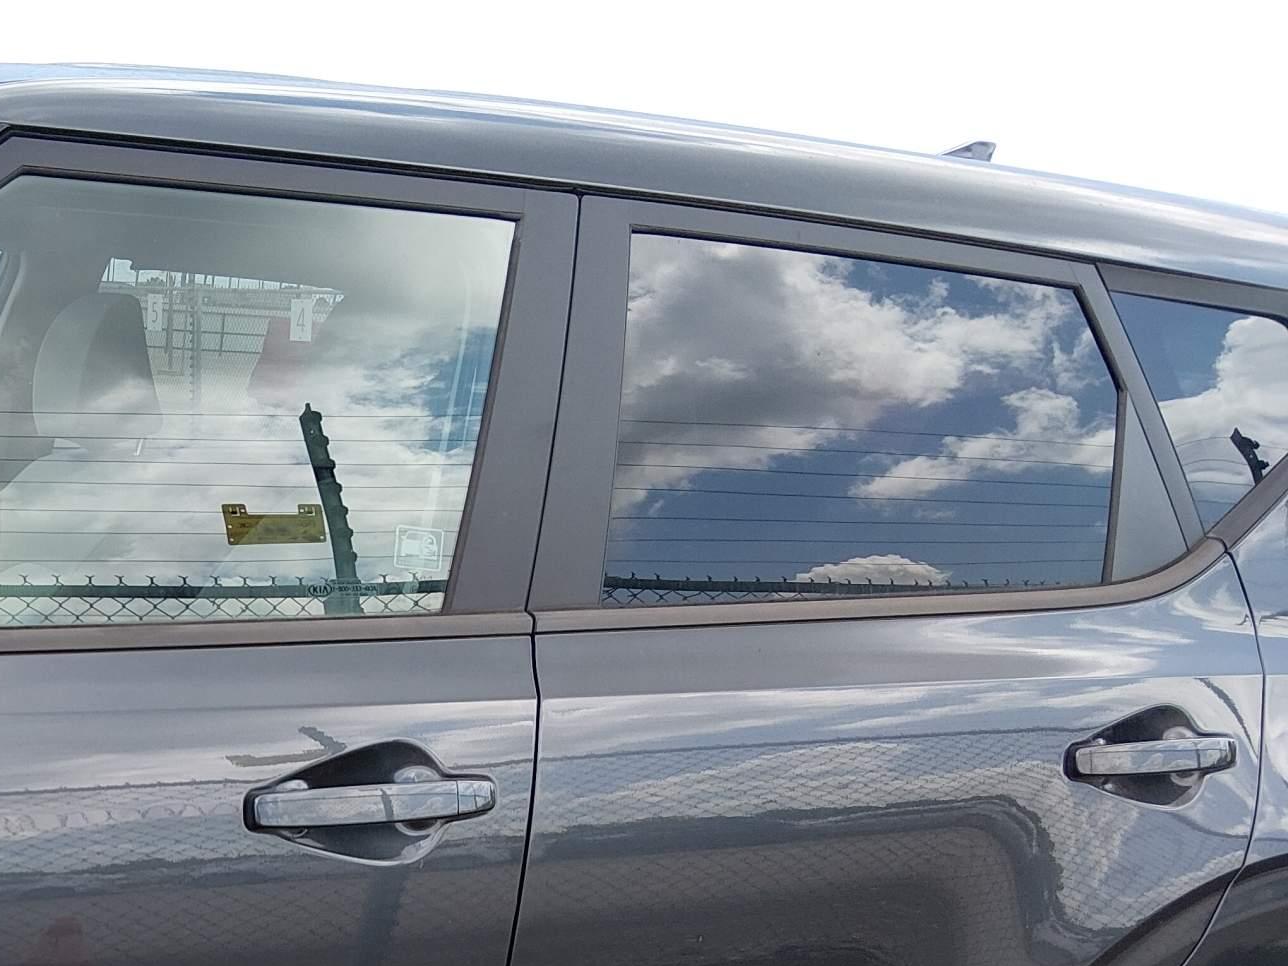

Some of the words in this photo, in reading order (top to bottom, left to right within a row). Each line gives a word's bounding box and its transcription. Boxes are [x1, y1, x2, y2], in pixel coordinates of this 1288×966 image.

[152, 302, 158, 323] 5
[296, 307, 305, 333] 4
[311, 584, 330, 595] KIA
